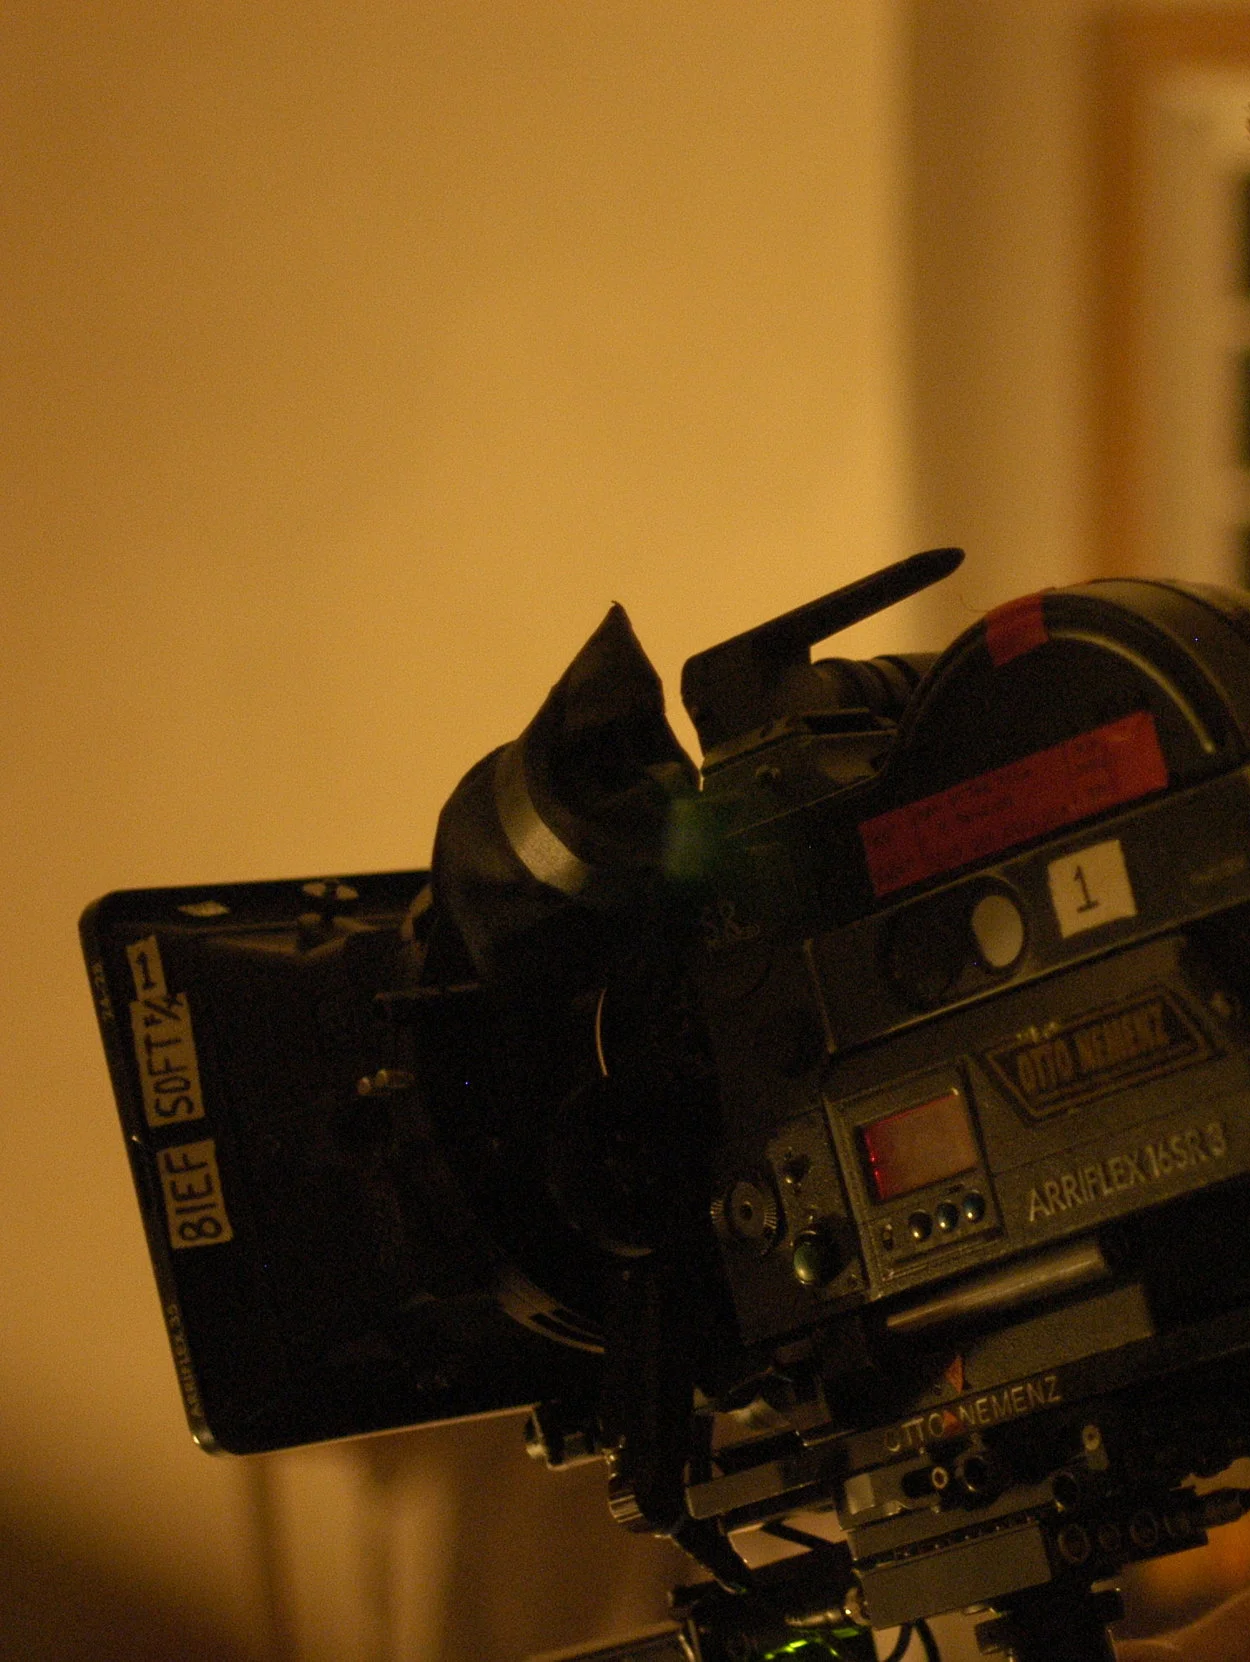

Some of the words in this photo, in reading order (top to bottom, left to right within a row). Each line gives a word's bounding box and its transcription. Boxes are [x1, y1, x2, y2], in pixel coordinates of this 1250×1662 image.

[1073, 865, 1100, 914] 1
[144, 1034, 194, 1117] SOFT
[1028, 1155, 1148, 1223] ARRIFLEX
[884, 1412, 946, 1453] OTTO
[958, 1374, 1063, 1427] NEMENZ
